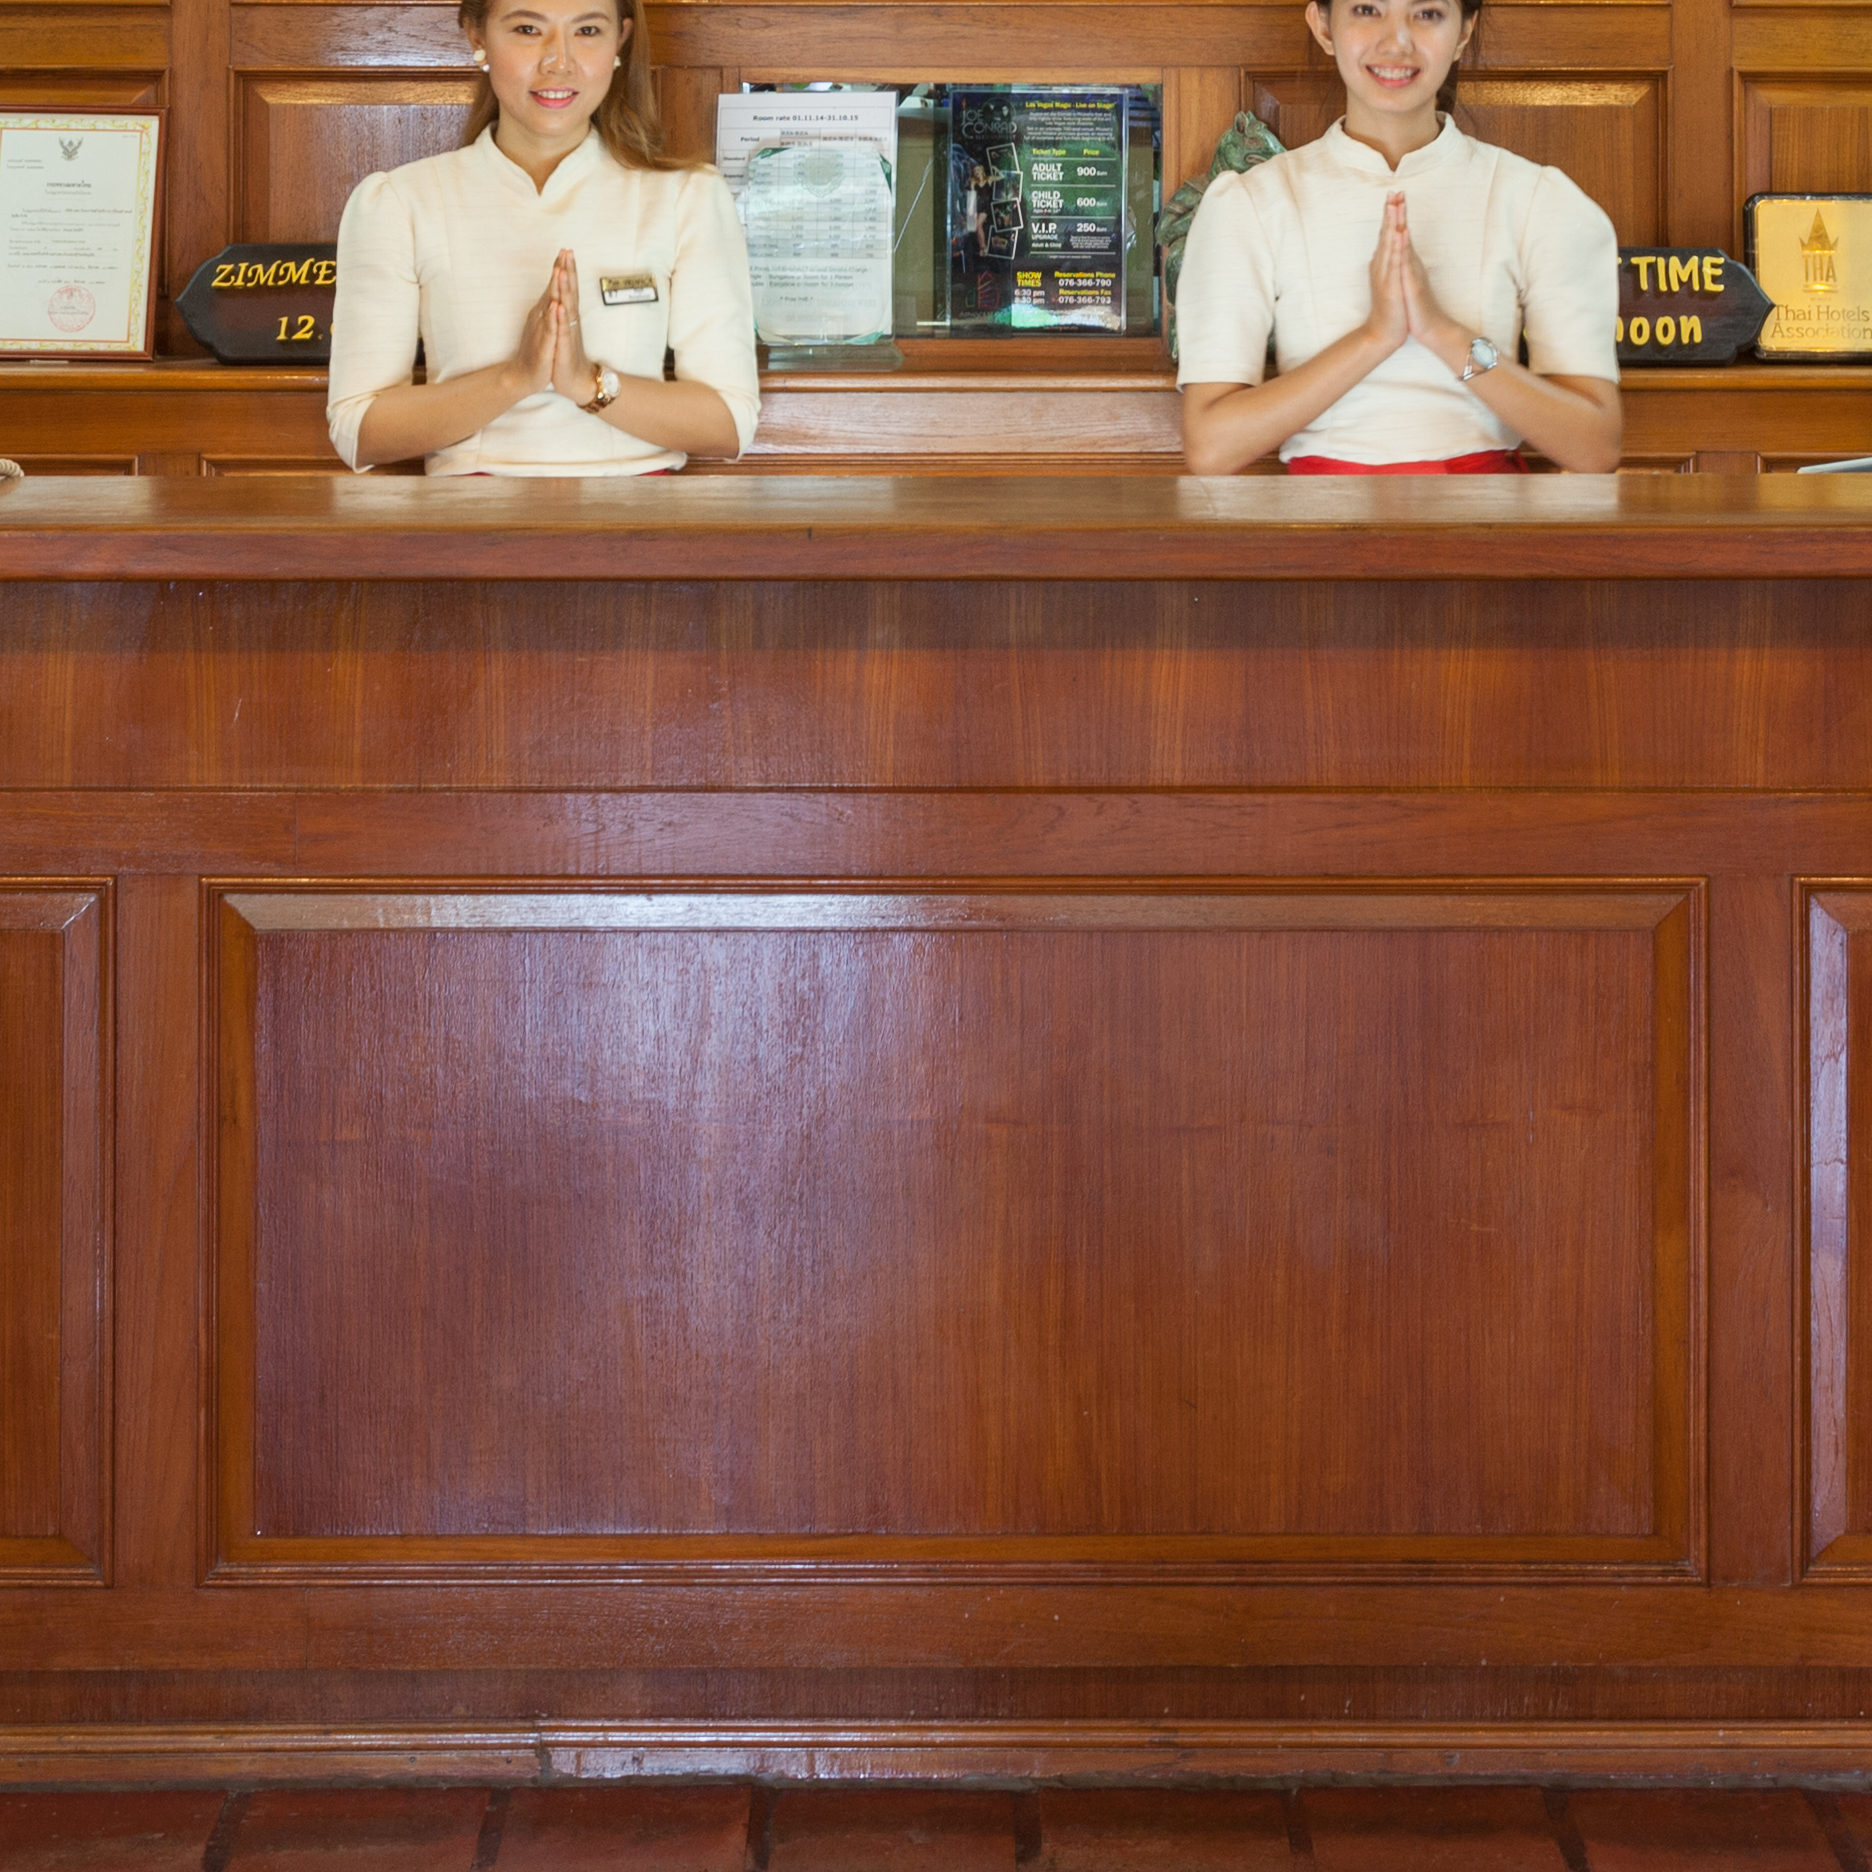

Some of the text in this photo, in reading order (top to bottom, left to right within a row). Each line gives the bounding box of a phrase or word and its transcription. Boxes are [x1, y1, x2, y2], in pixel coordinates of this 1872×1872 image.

[961, 109, 983, 125] JOE
[962, 122, 1017, 139] CONRAD
[1032, 163, 1062, 172] ADULT
[1077, 167, 1096, 176] 900
[1032, 172, 1064, 181] TICKET
[1032, 191, 1060, 199] CHILD
[1032, 199, 1064, 208] TICKET
[1077, 198, 1096, 207] 600
[1031, 223, 1057, 233] V.I.P.
[1077, 223, 1096, 232] 250
[211, 258, 337, 288] ZIMME
[1802, 255, 1837, 282] THA
[1631, 255, 1725, 292] TIME
[1017, 279, 1041, 287] TIMES
[1775, 304, 1870, 322] Thai Hotels
